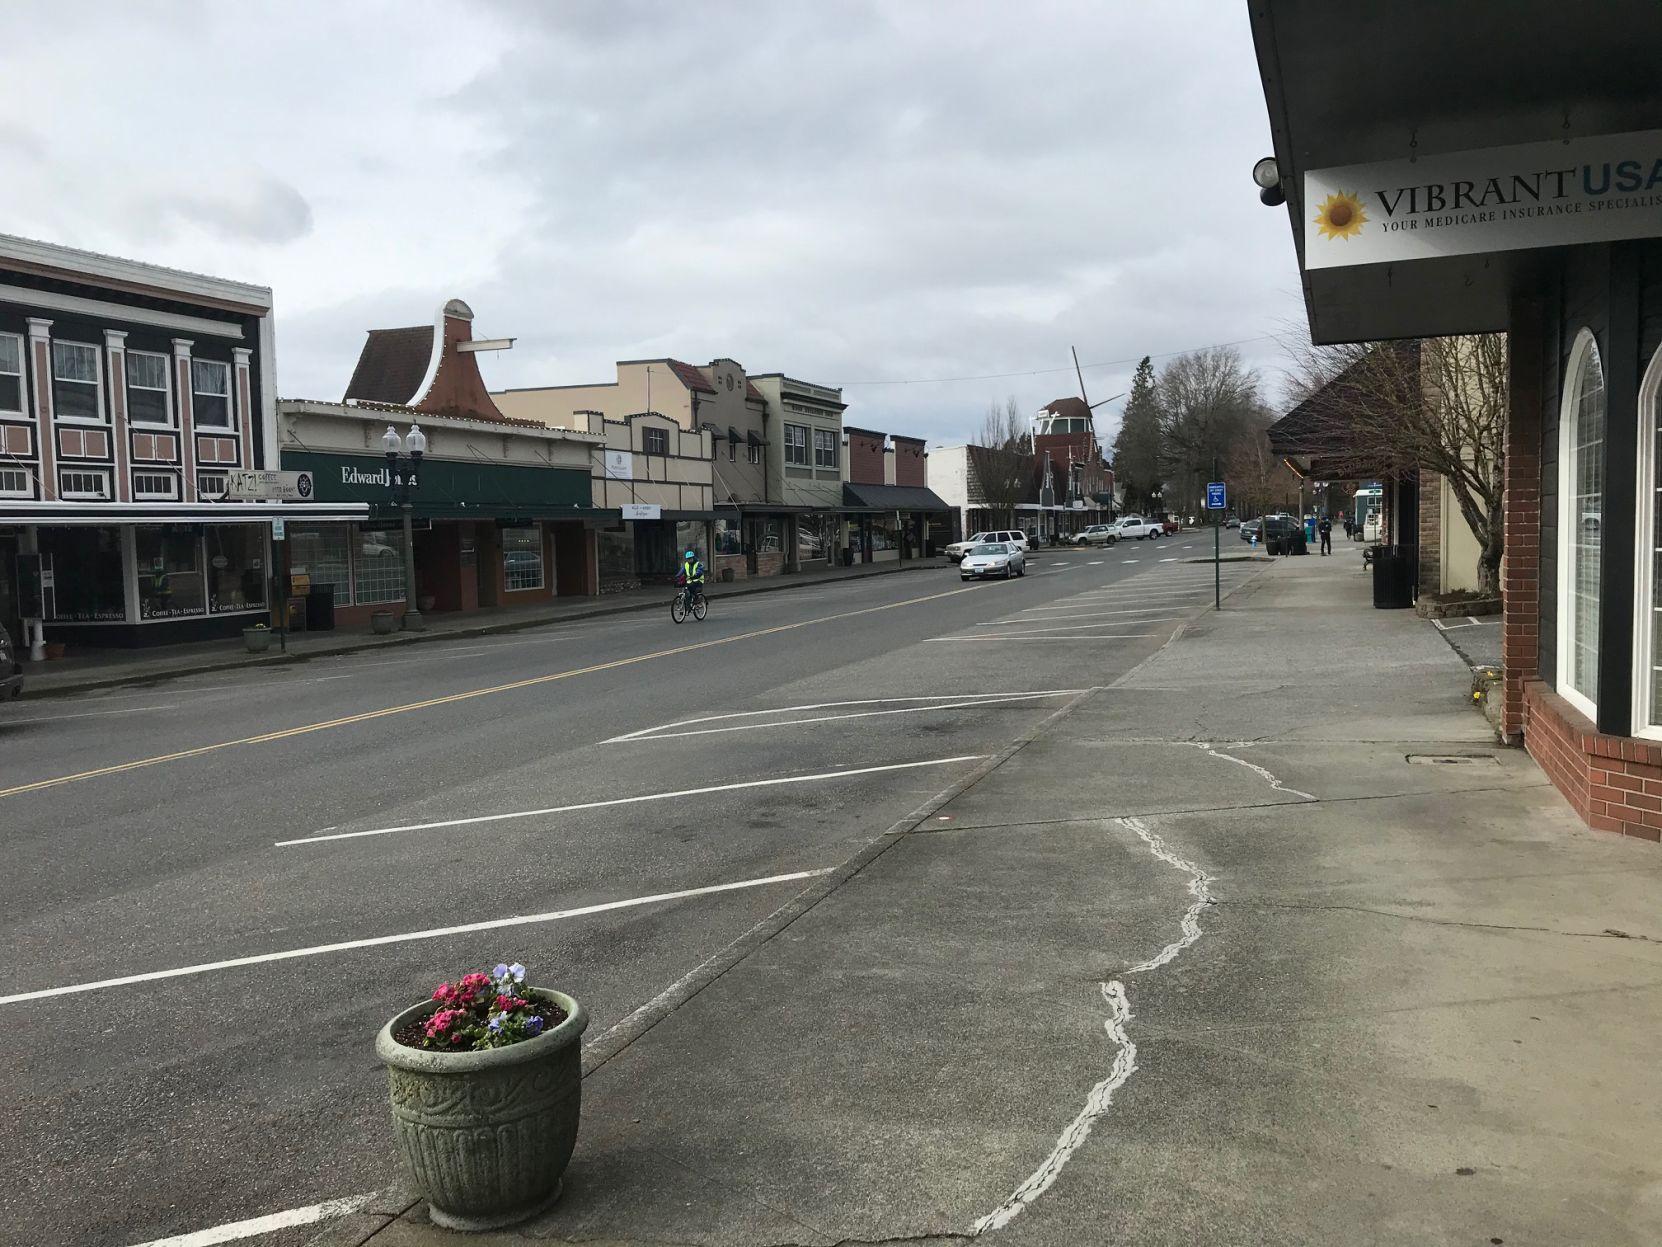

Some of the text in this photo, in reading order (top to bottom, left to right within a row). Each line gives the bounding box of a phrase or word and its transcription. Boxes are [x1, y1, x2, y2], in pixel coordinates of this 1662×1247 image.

[1374, 167, 1577, 218] VIBRANT
[1382, 220, 1419, 233] YOUR
[1424, 211, 1497, 229] MEDICARE
[1502, 202, 1583, 221] INSURANCE
[341, 466, 384, 485] Edward
